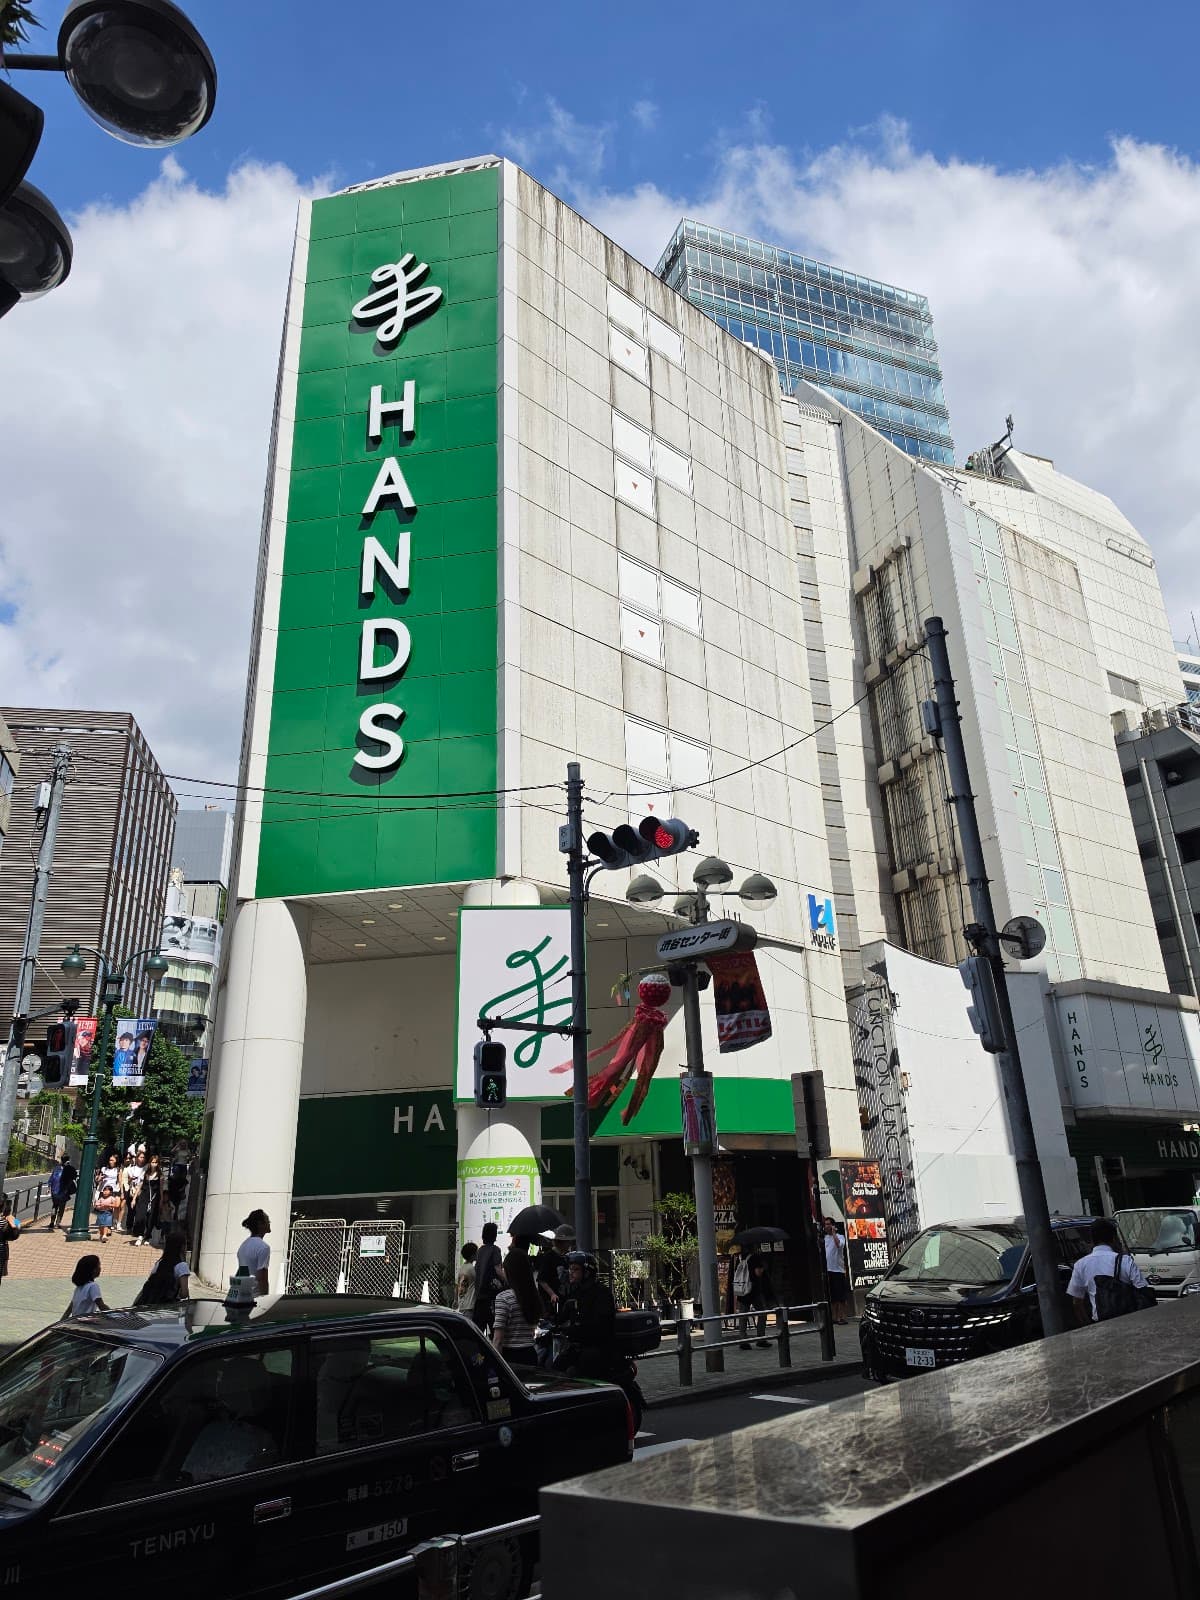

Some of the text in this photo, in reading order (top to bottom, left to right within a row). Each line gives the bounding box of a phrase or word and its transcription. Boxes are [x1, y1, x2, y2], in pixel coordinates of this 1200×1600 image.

[352, 379, 417, 769] HANDS
[811, 932, 836, 948] HULIC
[1067, 1011, 1089, 1089] HANDS
[1142, 1071, 1179, 1088] HANDS
[392, 1103, 446, 1134] HA
[1157, 1139, 1200, 1160] HAND
[515, 1178, 521, 1188] 2
[864, 1242, 887, 1252] LUNCH
[870, 1250, 889, 1260] CAFE
[863, 1259, 889, 1269] DINNER
